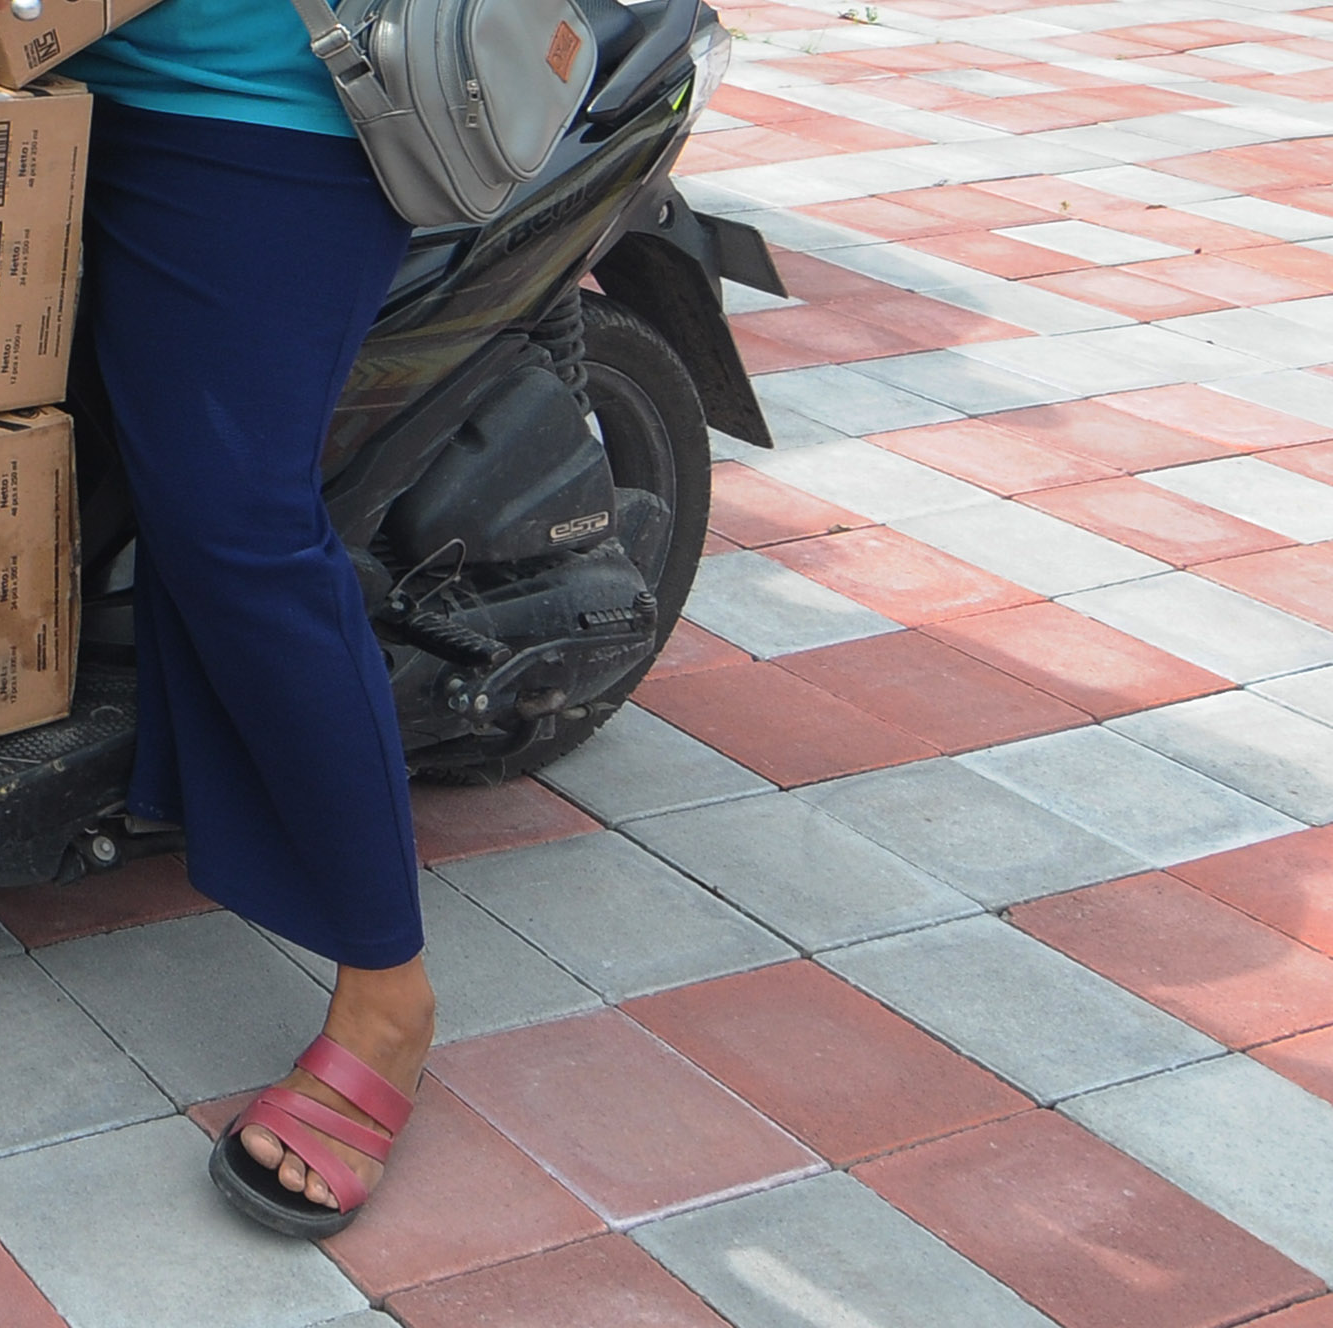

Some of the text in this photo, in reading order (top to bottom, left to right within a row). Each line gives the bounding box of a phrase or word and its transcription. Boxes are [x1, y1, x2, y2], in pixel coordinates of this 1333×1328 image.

[19, 147, 28, 177] Netto
[10, 247, 20, 276] Netto
[1, 344, 11, 373] Netto
[0, 479, 9, 508] Netto
